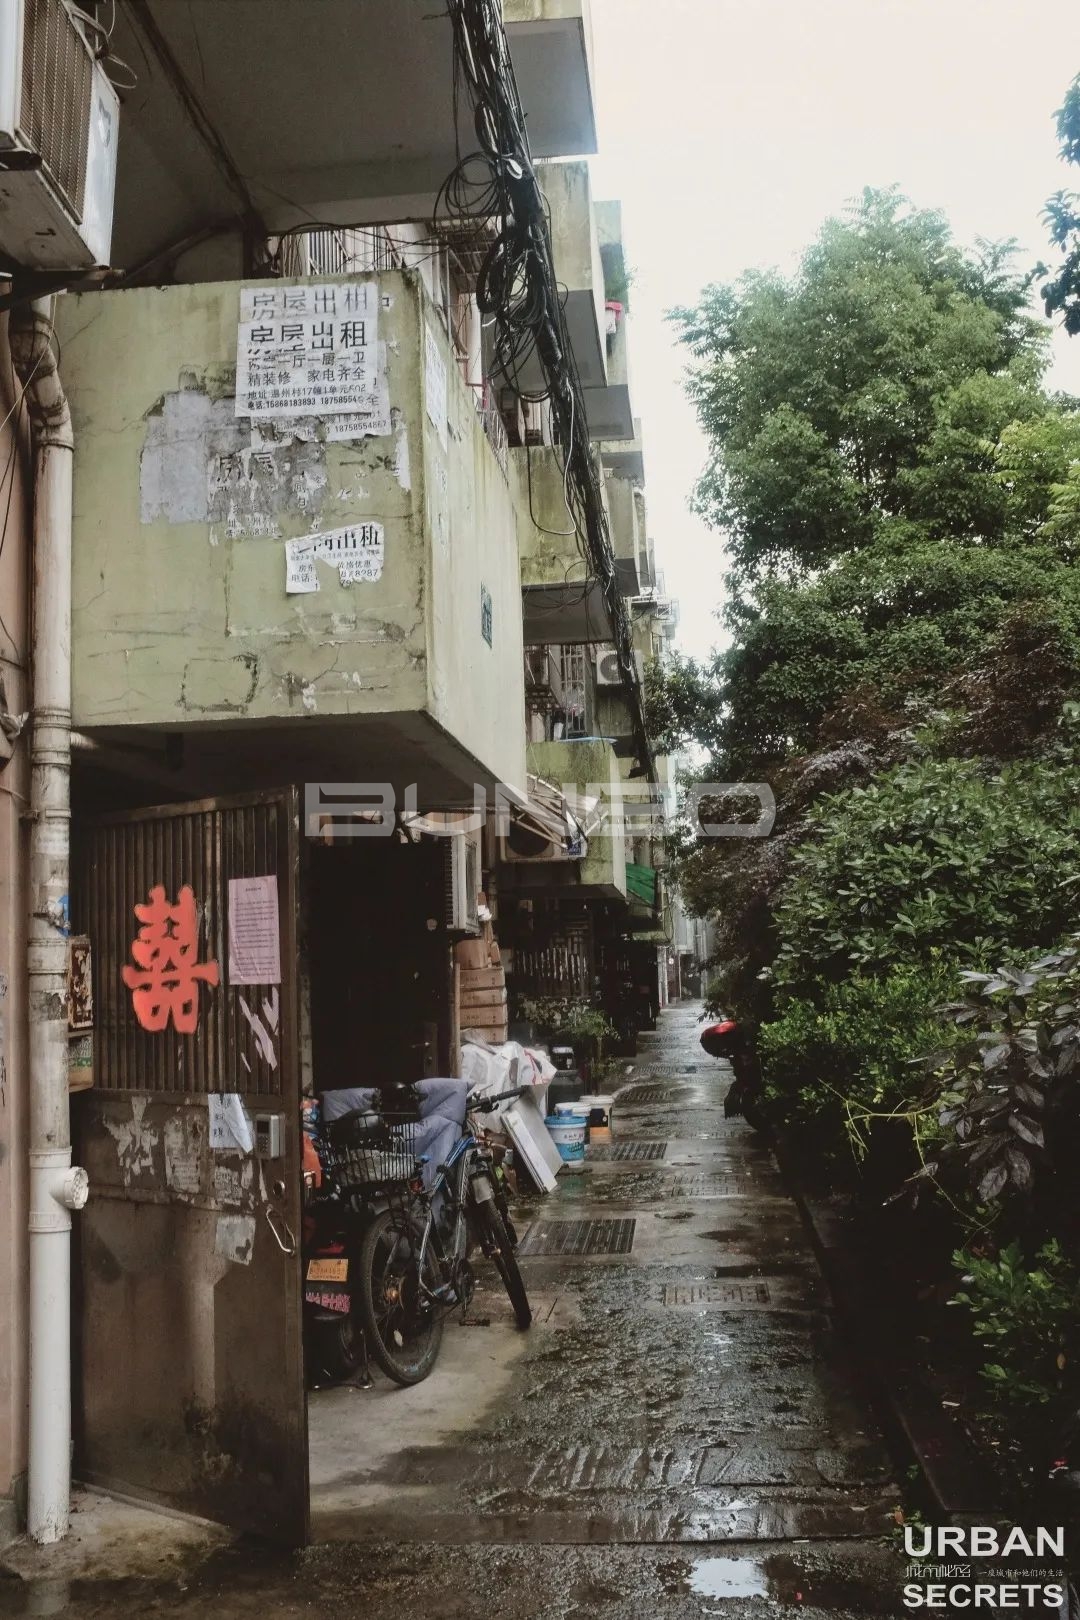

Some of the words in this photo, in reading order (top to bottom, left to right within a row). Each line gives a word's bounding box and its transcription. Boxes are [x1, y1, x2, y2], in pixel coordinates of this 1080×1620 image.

[252, 287, 368, 320] 房屋出租
[248, 321, 368, 355] 房屋出租
[248, 371, 291, 387] 精装修
[307, 366, 366, 382] 家电齐全
